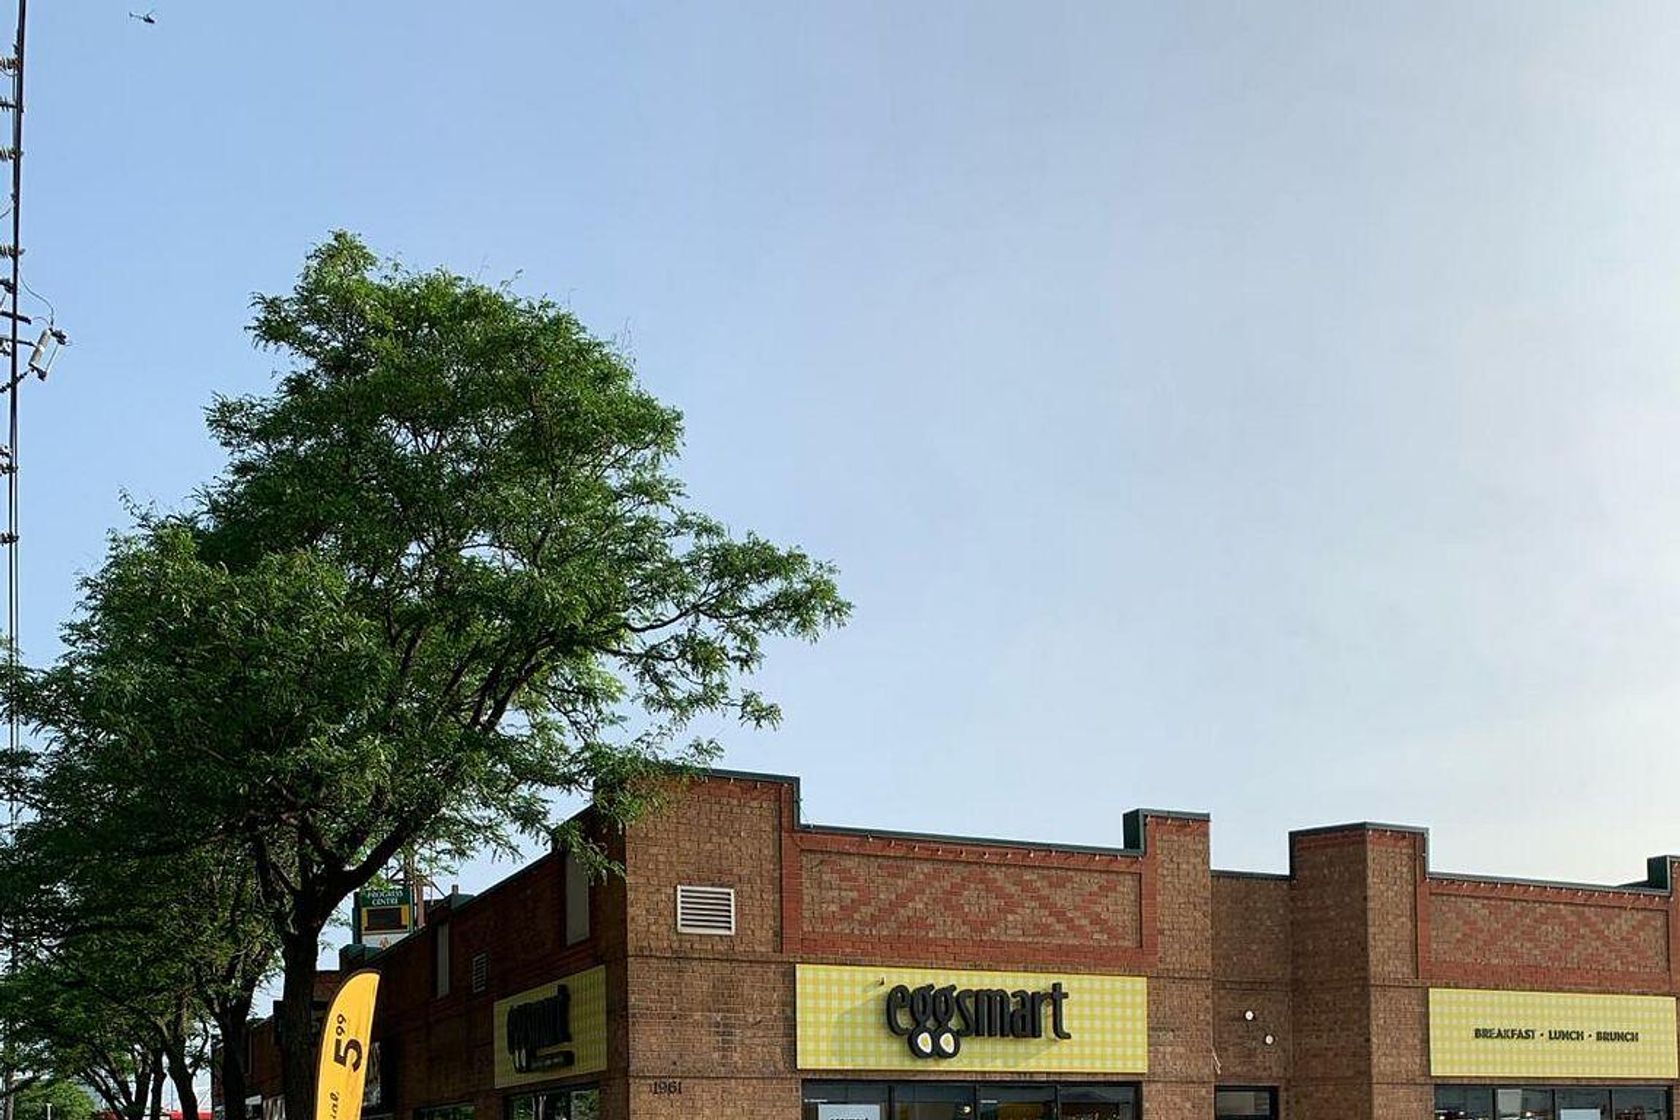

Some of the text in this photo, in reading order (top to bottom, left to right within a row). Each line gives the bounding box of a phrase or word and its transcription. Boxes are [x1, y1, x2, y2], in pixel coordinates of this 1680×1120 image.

[886, 982, 1072, 1059] eggsmart
[1474, 1027, 1639, 1043] BREAKFAST LUNCH BRUNCH
[653, 1081, 682, 1095] 1961
